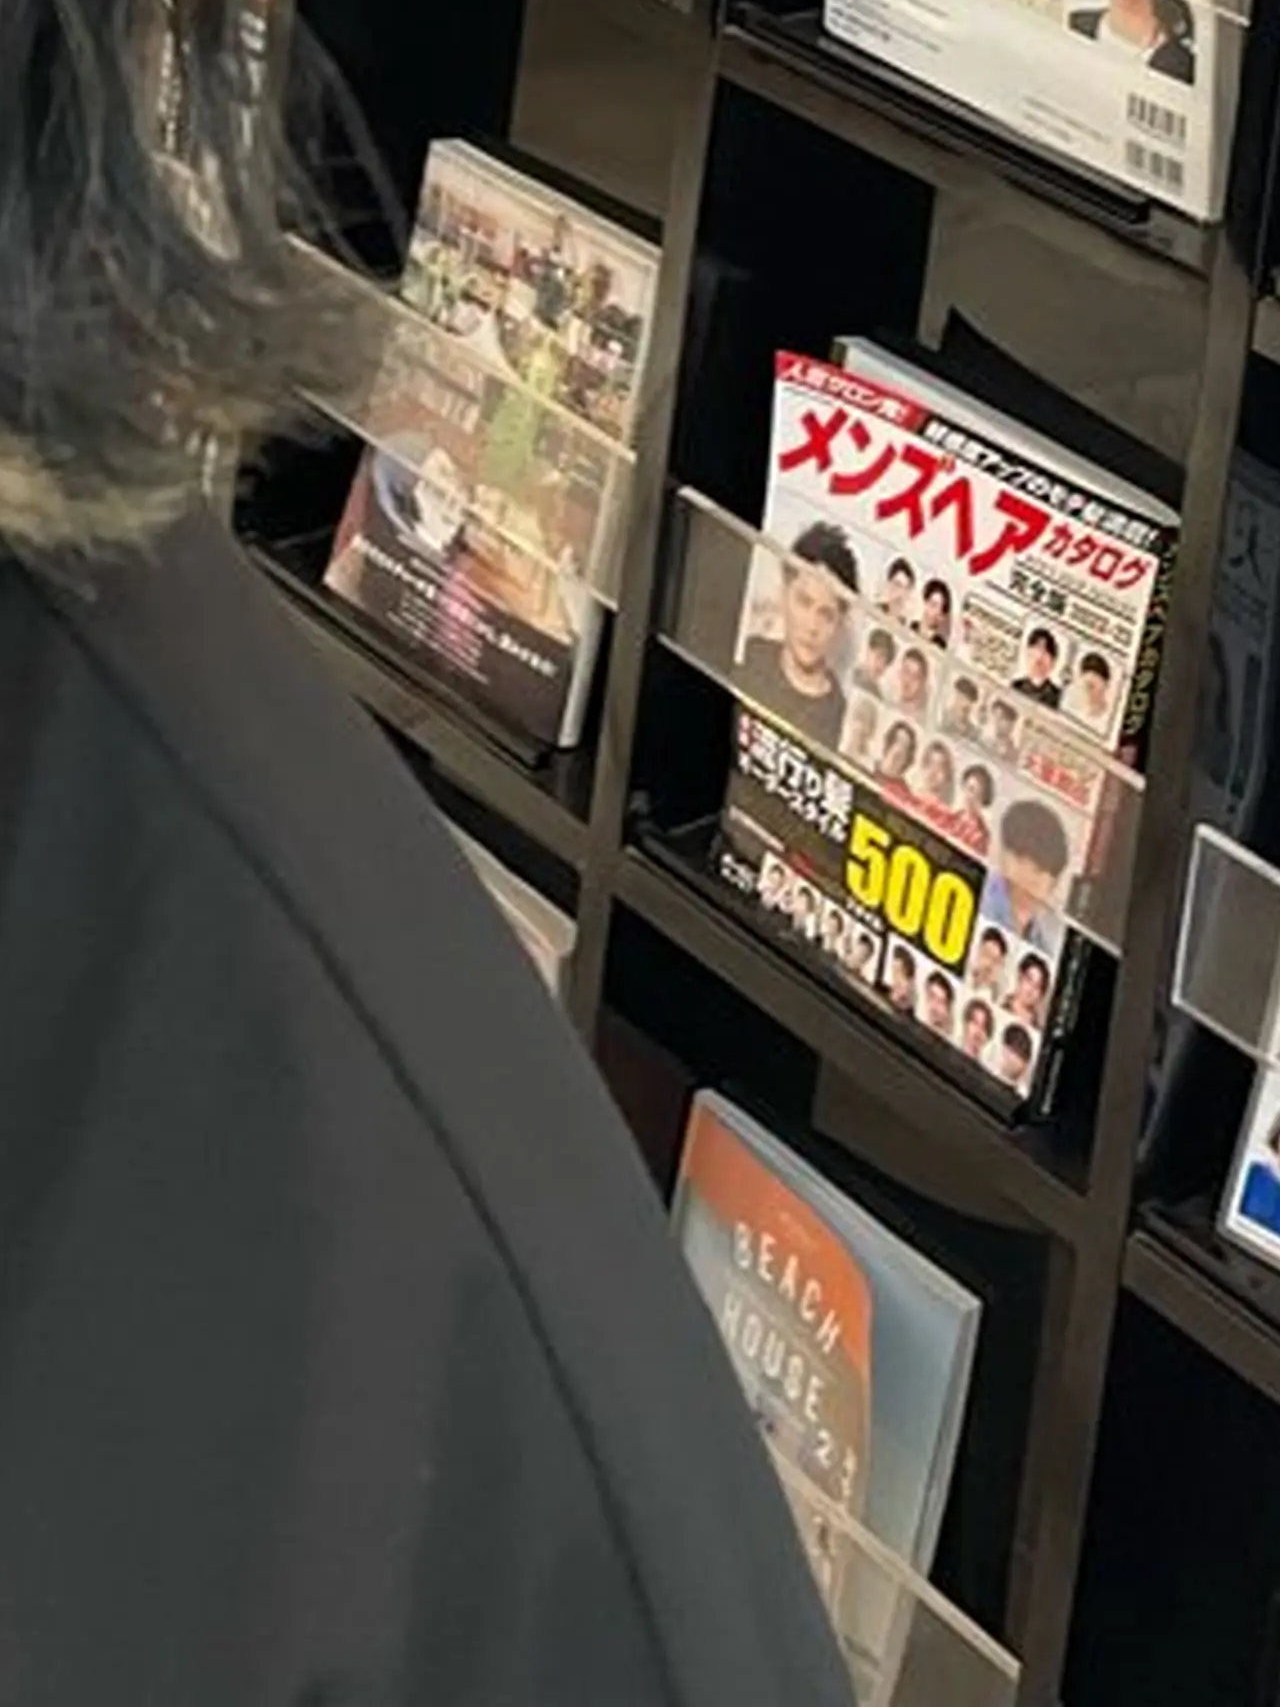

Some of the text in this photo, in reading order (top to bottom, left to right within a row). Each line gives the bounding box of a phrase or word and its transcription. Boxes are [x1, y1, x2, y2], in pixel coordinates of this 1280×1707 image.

[777, 407, 1153, 590] メンズヘア カタログ
[844, 812, 975, 965] 500
[721, 1287, 824, 1424] HOUSE
[732, 1221, 842, 1356] BEACH
